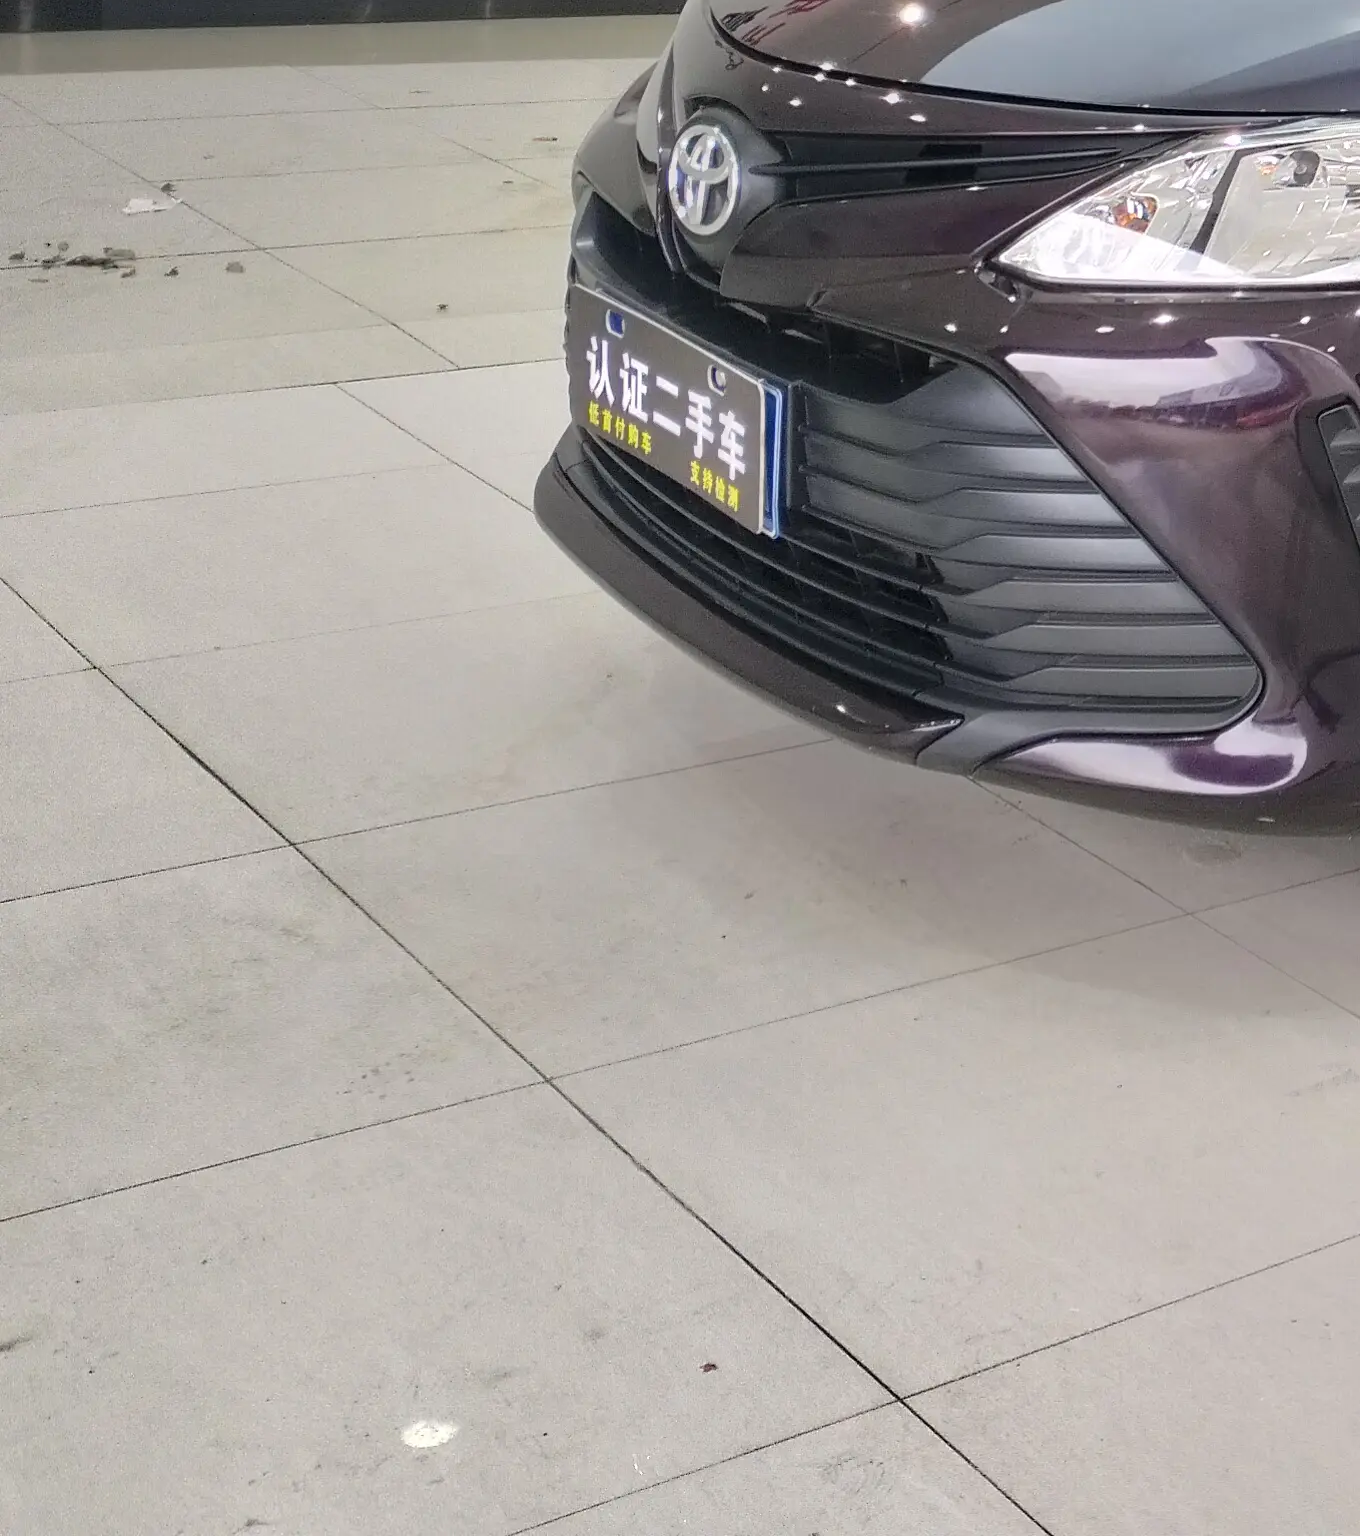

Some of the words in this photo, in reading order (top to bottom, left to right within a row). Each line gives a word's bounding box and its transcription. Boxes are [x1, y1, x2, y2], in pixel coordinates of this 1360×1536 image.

[586, 335, 746, 482] 认证二手车
[587, 400, 652, 456] 低首付购车
[690, 460, 741, 512] 支持检测
